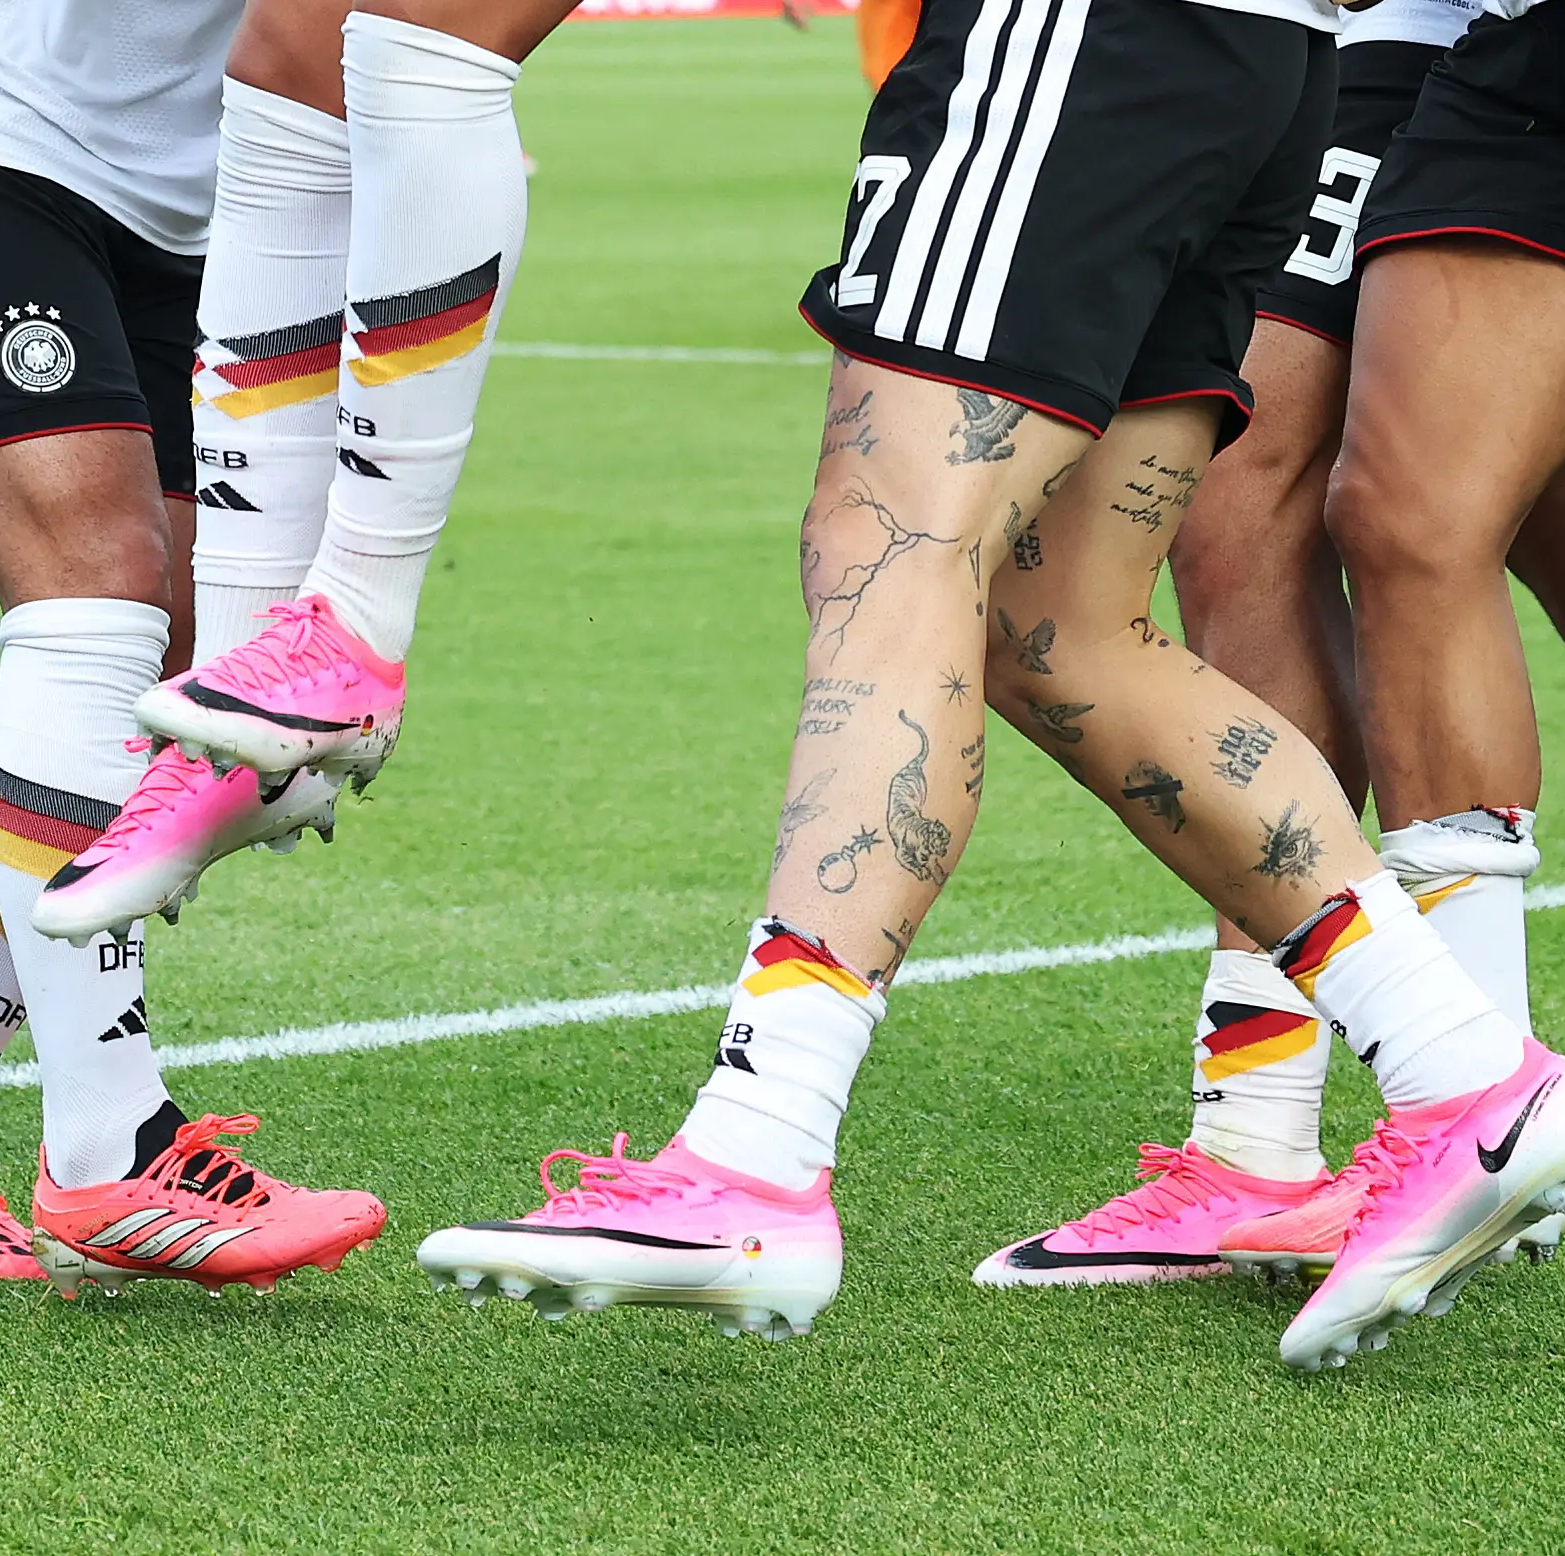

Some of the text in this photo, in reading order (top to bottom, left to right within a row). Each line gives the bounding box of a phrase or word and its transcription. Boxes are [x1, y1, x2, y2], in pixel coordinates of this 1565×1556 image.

[13, 329, 54, 350] DEUTSCHER
[337, 405, 377, 437] FB
[719, 1022, 754, 1046] FB
